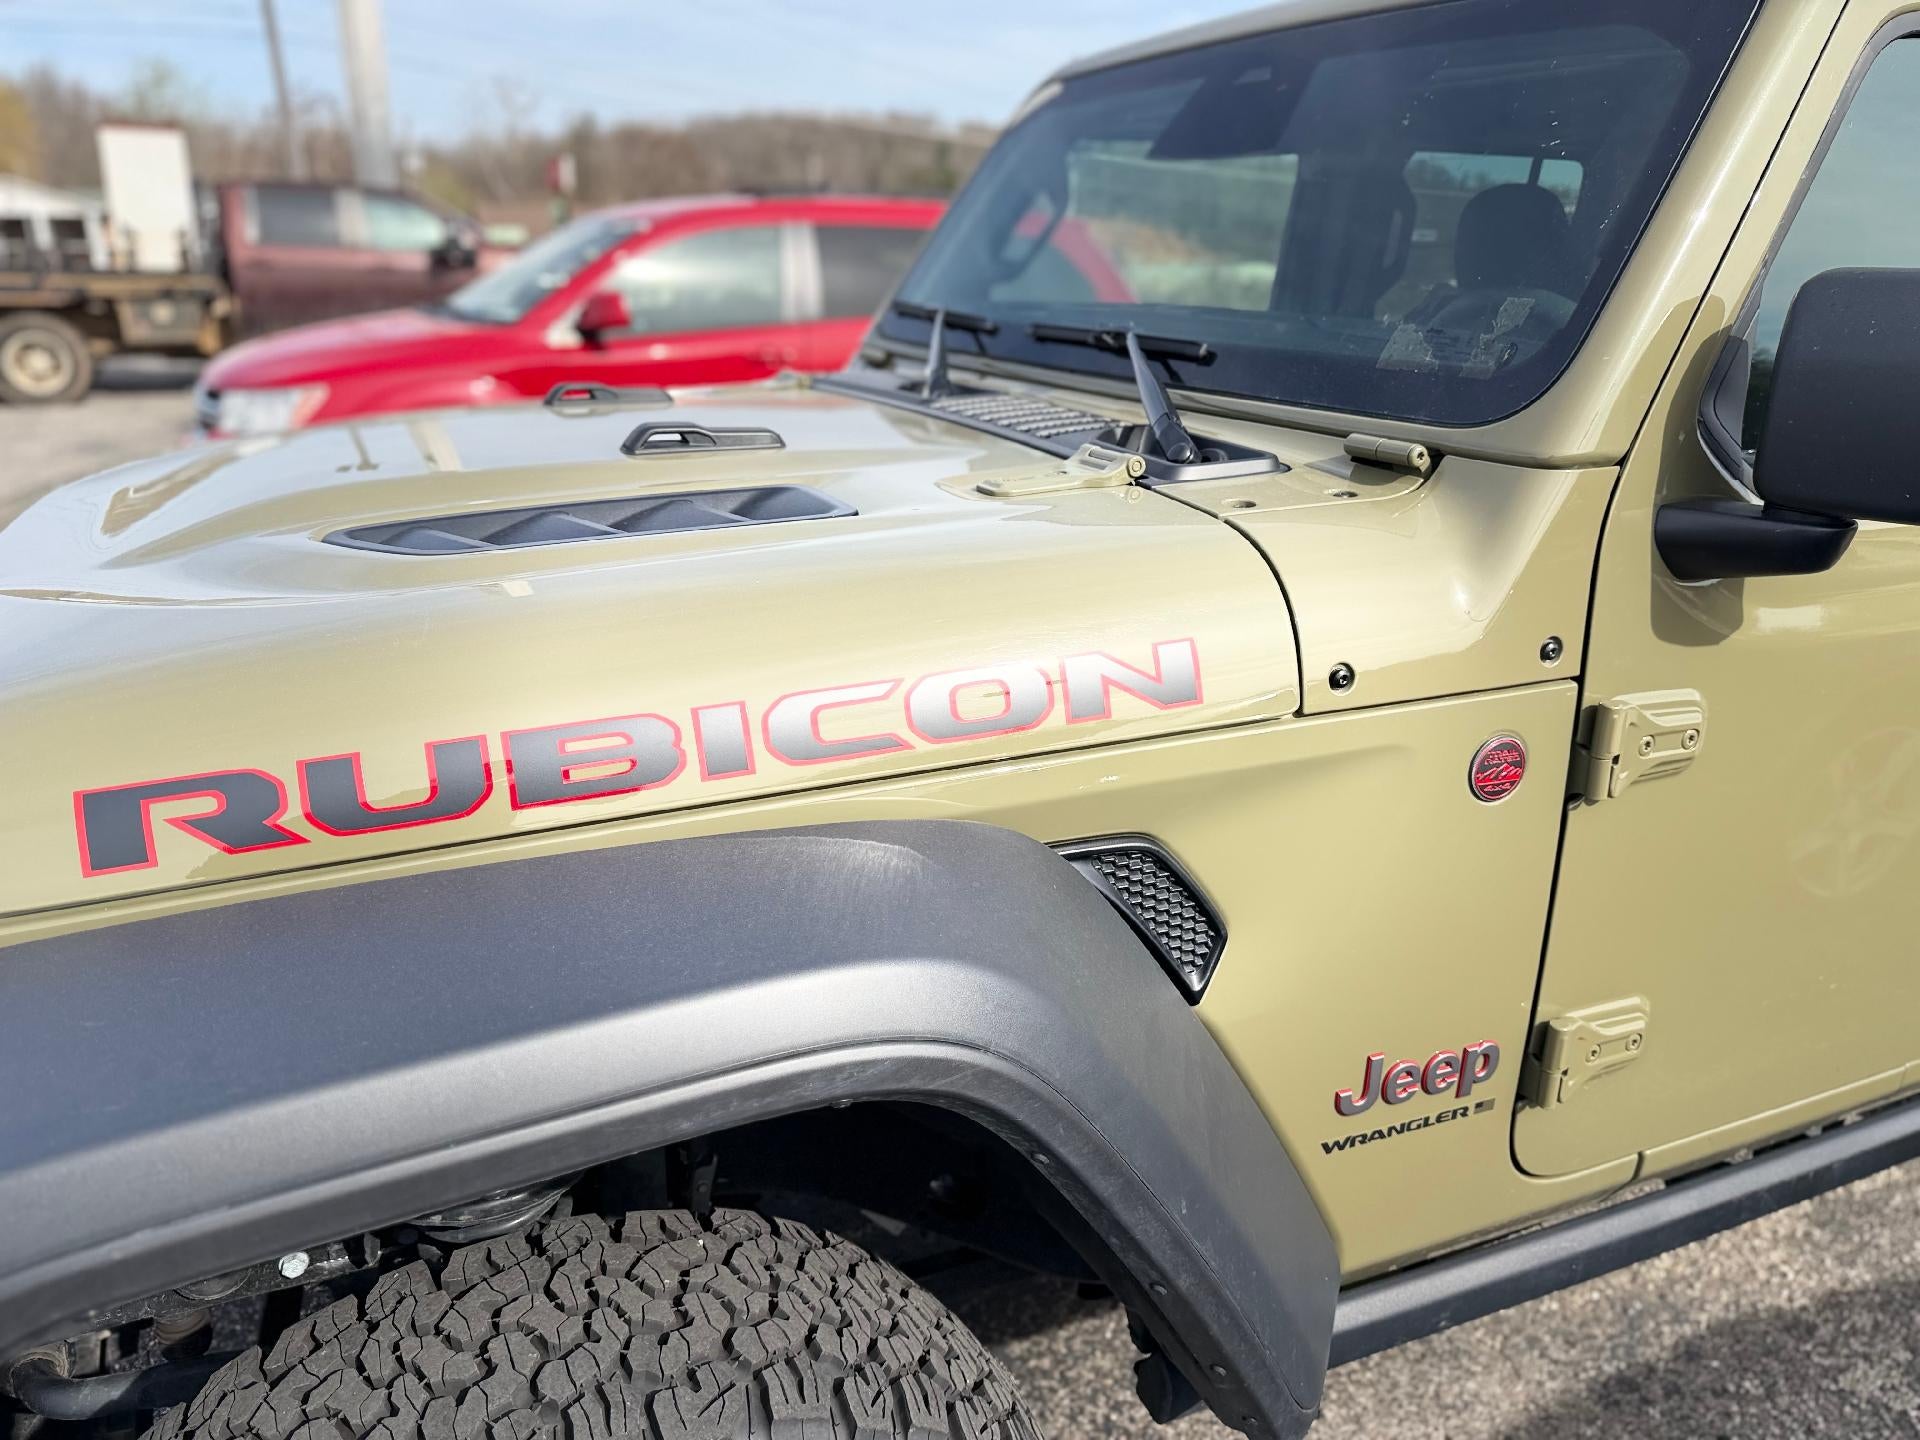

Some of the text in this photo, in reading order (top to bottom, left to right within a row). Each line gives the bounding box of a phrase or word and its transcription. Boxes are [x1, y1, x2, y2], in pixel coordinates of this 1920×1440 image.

[73, 637, 1203, 877] RUBICON
[1334, 1040, 1500, 1116] Jeep
[1321, 1106, 1469, 1155] WRANGLER
